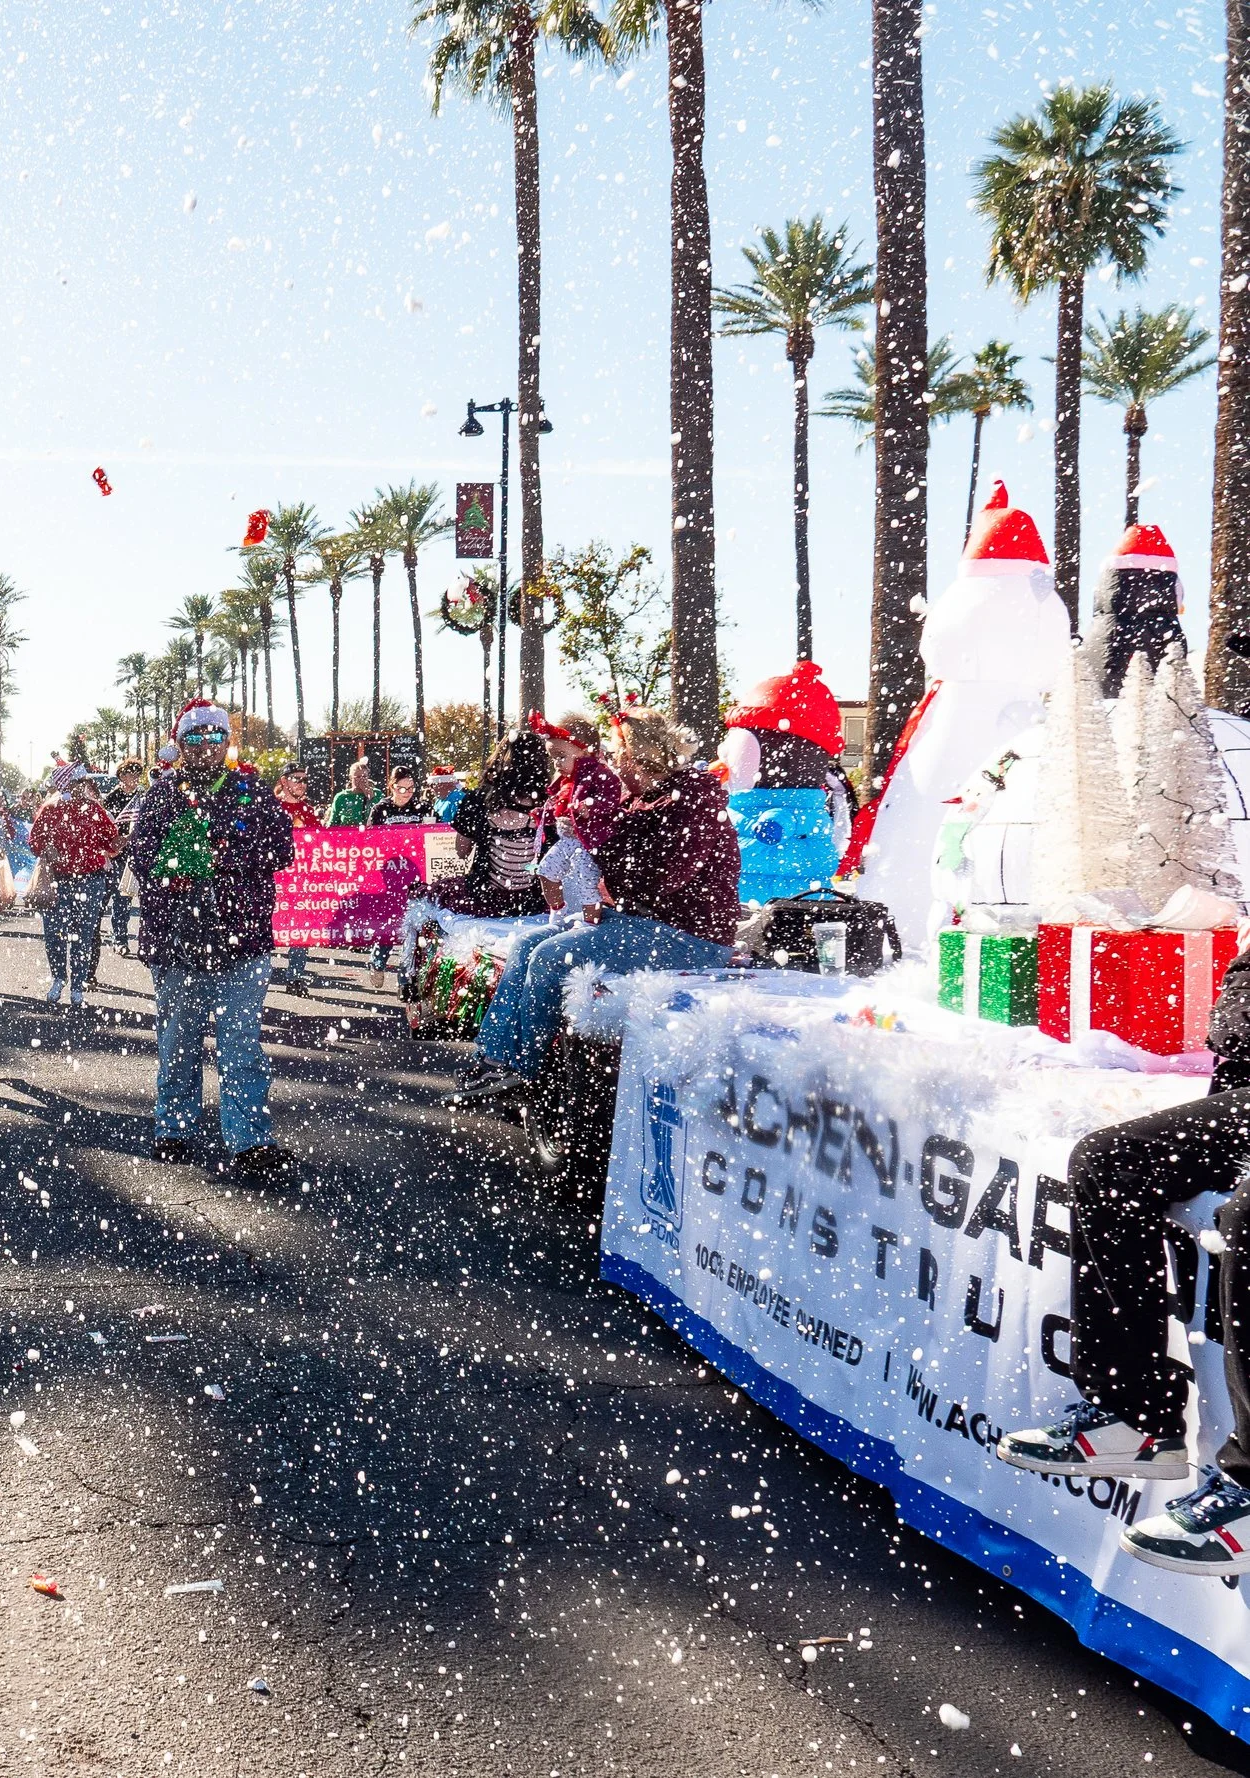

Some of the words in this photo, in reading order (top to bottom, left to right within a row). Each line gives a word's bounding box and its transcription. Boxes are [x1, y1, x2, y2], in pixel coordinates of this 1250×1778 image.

[294, 849, 305, 859] H
[312, 847, 385, 859] SCHOOL
[285, 861, 357, 873] CHANGE
[363, 859, 408, 871] YEAR
[275, 884, 283, 893] e
[288, 884, 297, 893] a
[302, 880, 358, 896] foreign
[273, 901, 289, 913] ge
[272, 926, 373, 941] ngeyear.org
[702, 1150, 1150, 1384] CONSTRUC
[727, 1262, 791, 1329] EMPLOYEE
[796, 1308, 864, 1367] OWNED
